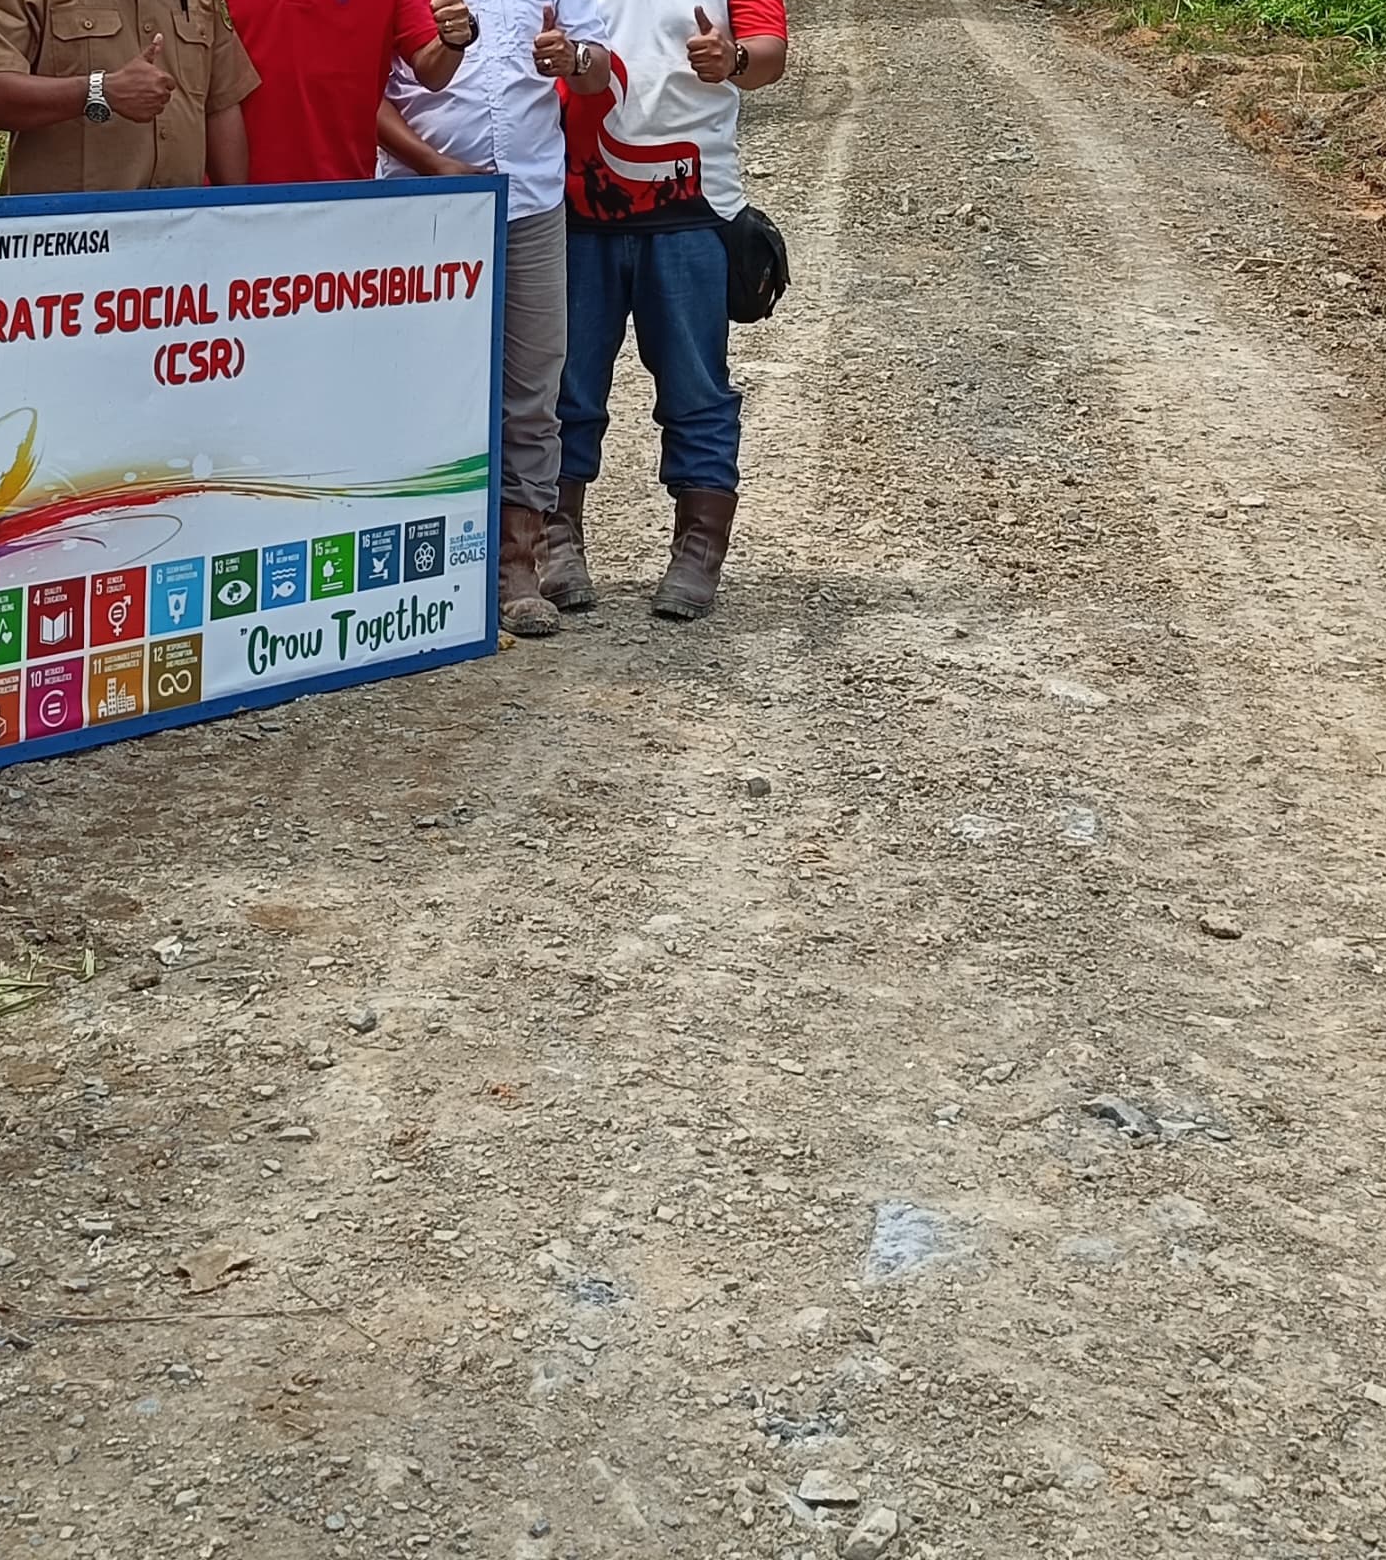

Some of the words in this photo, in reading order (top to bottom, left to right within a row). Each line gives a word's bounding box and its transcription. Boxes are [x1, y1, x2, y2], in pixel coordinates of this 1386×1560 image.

[33, 229, 110, 257] PERKASA
[94, 283, 218, 334] SOCIAL
[228, 260, 483, 321] RESPONSIBILITY
[154, 337, 245, 385] (CSR)
[408, 526, 416, 539] 17
[362, 534, 370, 548] 16
[315, 542, 323, 557] 15
[450, 547, 486, 566] GOALS
[265, 551, 274, 566] 14
[215, 560, 224, 575] 13
[157, 568, 163, 584] 6
[96, 579, 102, 595] 5
[33, 589, 40, 606] 4
[153, 646, 163, 662] 12
[93, 658, 102, 675] 11
[30, 670, 42, 688] 10
